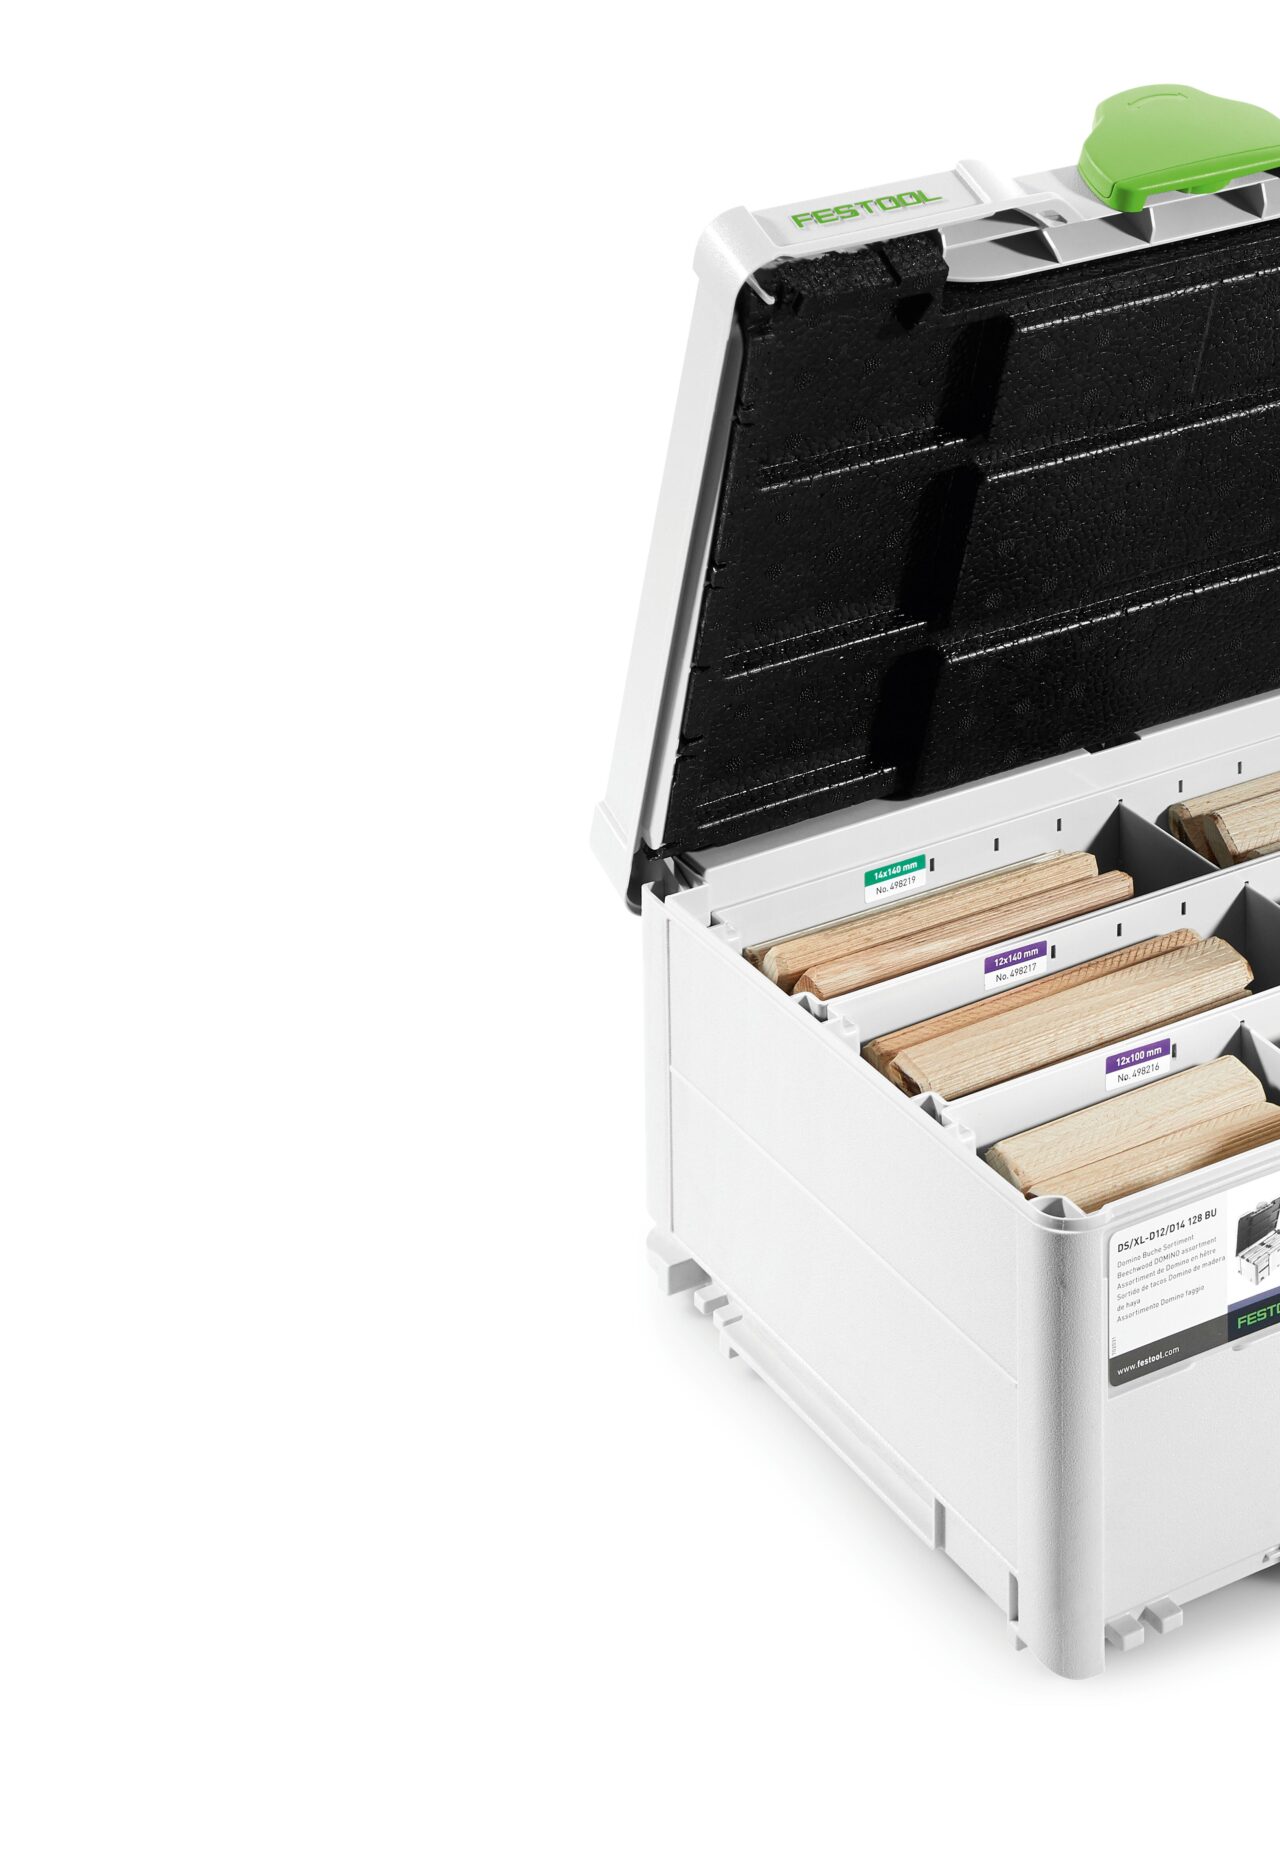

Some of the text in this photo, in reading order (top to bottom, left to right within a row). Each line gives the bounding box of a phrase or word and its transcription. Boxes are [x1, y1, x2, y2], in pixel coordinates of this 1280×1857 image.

[791, 190, 943, 229] FESTOOL
[874, 862, 917, 880] 14x140 mm
[876, 876, 916, 895] No. 498219
[995, 948, 1038, 967] 12x140 mm
[996, 963, 1036, 982] No. 498217
[1116, 1047, 1161, 1066] 12x100 mm
[1118, 1062, 1159, 1083] No. 498216
[1117, 1208, 1217, 1253] DS/XL-D12/D14 128 BU
[1117, 1234, 1194, 1268] Domino Buche Sortiment
[1117, 1237, 1217, 1279] Beechwood DOMINO assortment
[1117, 1271, 1156, 1290] Assortiment
[1166, 1259, 1189, 1272] Domino
[1200, 1248, 1216, 1258] hêtre
[1117, 1256, 1225, 1300] Sortido de tacos Domino de madera
[1117, 1285, 1204, 1322] Assortimento Domino faggio
[1126, 1299, 1140, 1308] haya
[1117, 1347, 1180, 1375] www.festool.com
